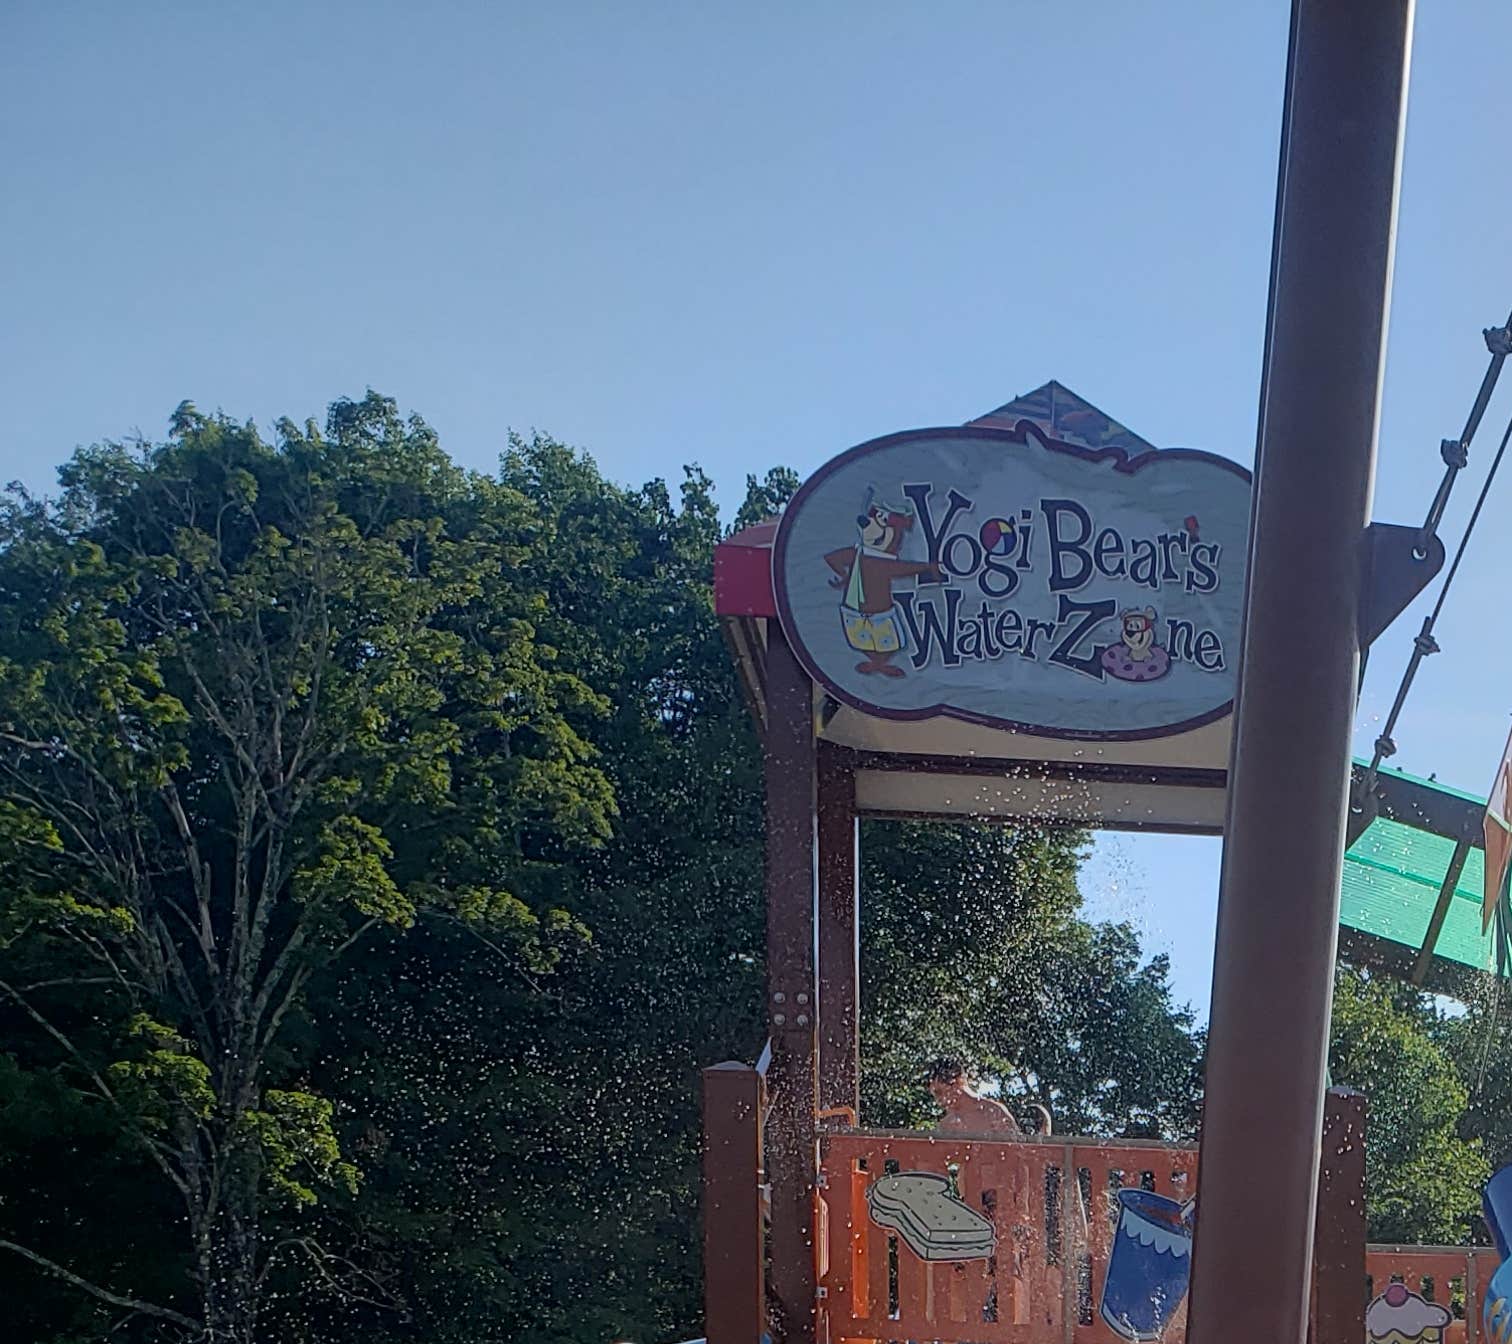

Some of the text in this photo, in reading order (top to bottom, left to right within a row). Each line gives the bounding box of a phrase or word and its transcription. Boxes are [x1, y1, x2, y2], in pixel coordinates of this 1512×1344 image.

[903, 483, 1220, 597] Yogi Bear's
[893, 588, 1055, 669] Water
